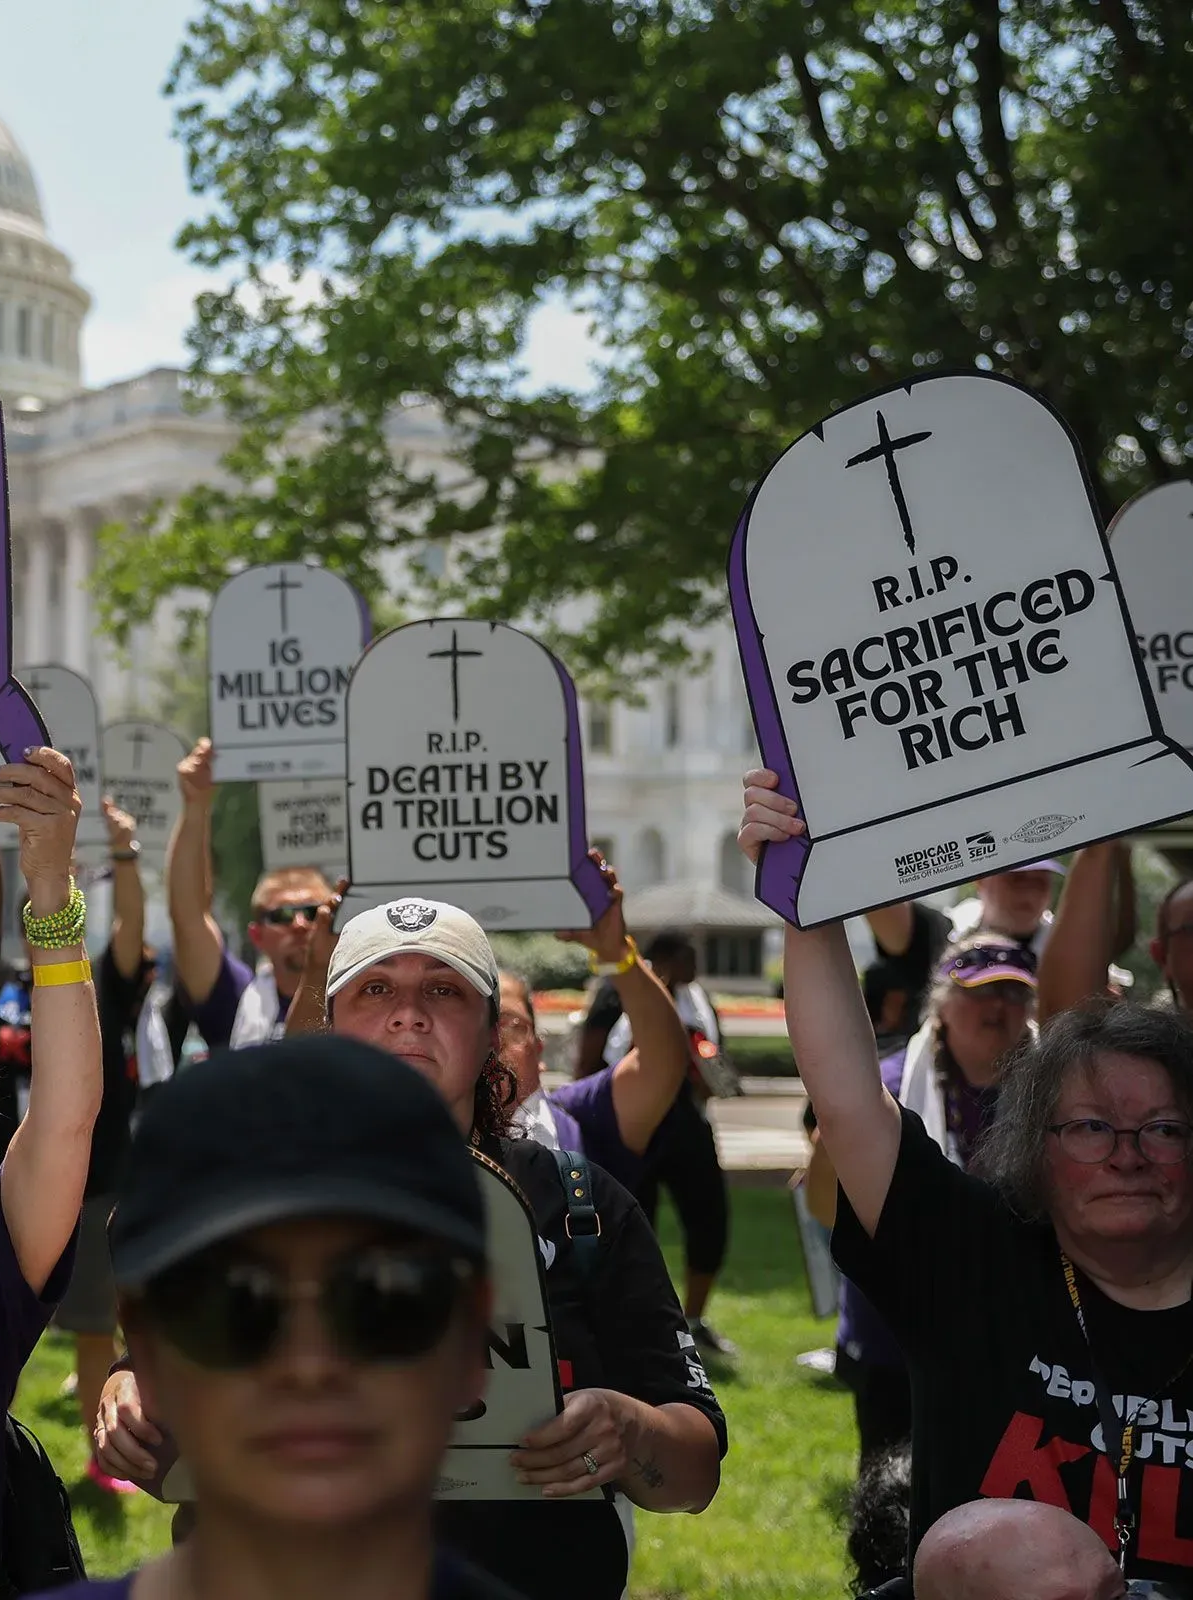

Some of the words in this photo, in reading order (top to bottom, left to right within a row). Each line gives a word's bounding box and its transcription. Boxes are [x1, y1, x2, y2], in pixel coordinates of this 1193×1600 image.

[871, 555, 973, 613] R.I.P.
[786, 568, 1096, 704] SACRIFICED
[267, 638, 302, 667] 16
[217, 666, 350, 700] MILLION
[834, 669, 948, 740] FOR
[953, 628, 1069, 699] THE
[238, 700, 338, 731] LIVES
[897, 691, 1027, 771] RICH
[427, 731, 488, 754] R.I.P.
[367, 762, 489, 795] DEATH
[499, 760, 549, 791] BY
[361, 800, 383, 830] A
[393, 794, 559, 829] TRILLION
[413, 830, 509, 862] CUTS
[894, 840, 959, 868] MEDICAID
[968, 843, 996, 860] SEIU
[897, 860, 930, 877] SAVES
[931, 851, 962, 868] LIVES
[899, 873, 921, 885] Hands
[920, 869, 933, 879] Off
[933, 861, 964, 876] Medicaid
